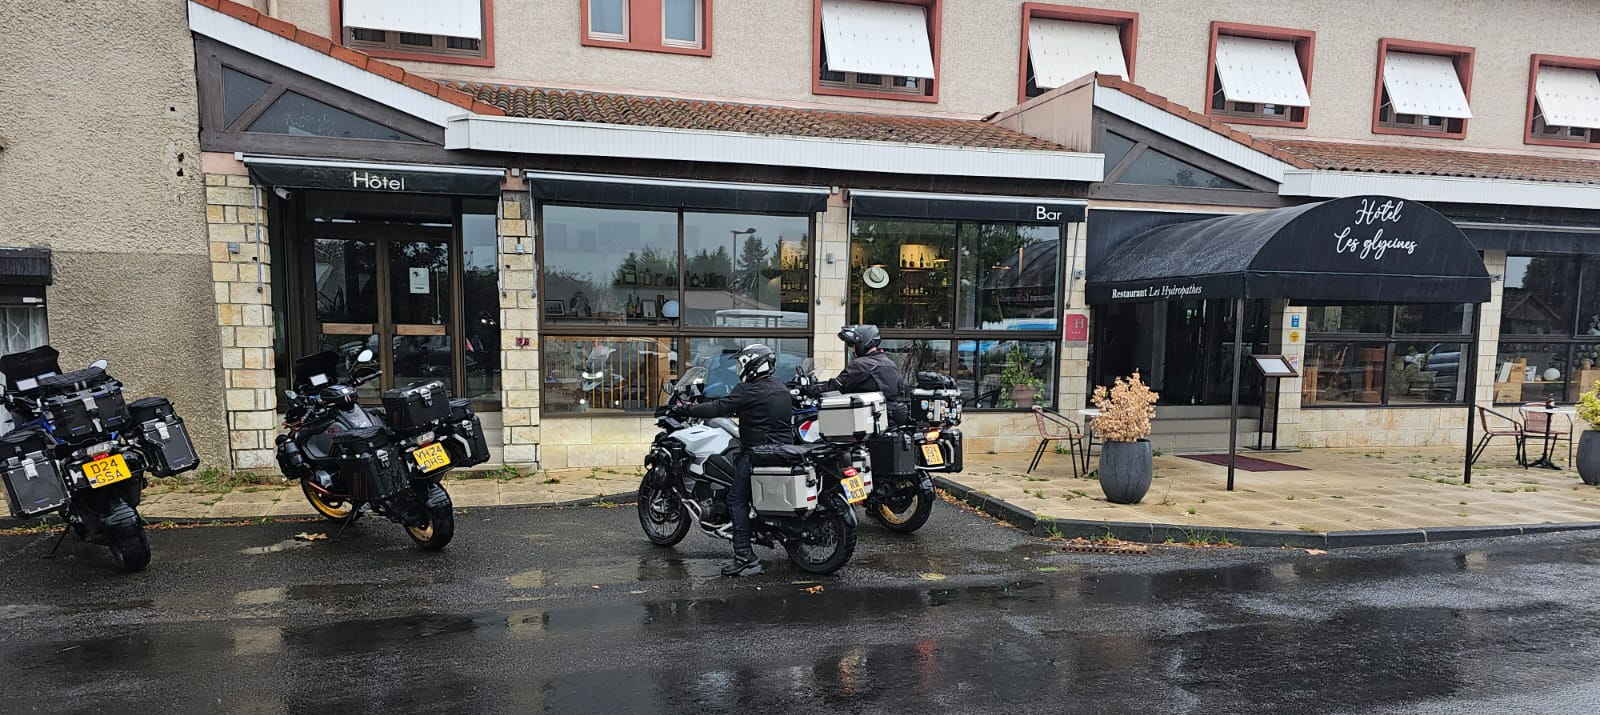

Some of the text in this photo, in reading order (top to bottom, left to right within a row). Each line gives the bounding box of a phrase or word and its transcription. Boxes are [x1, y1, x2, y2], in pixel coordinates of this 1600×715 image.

[353, 170, 405, 191] Hôtel
[1036, 206, 1063, 221] Bar
[1355, 198, 1404, 225] Hôtel
[1334, 226, 1418, 260] Les glycines
[1111, 283, 1202, 299] Restaurant Les Hydropathes
[1074, 318, 1085, 329] H
[90, 458, 118, 474] D24
[95, 469, 123, 484] GSA
